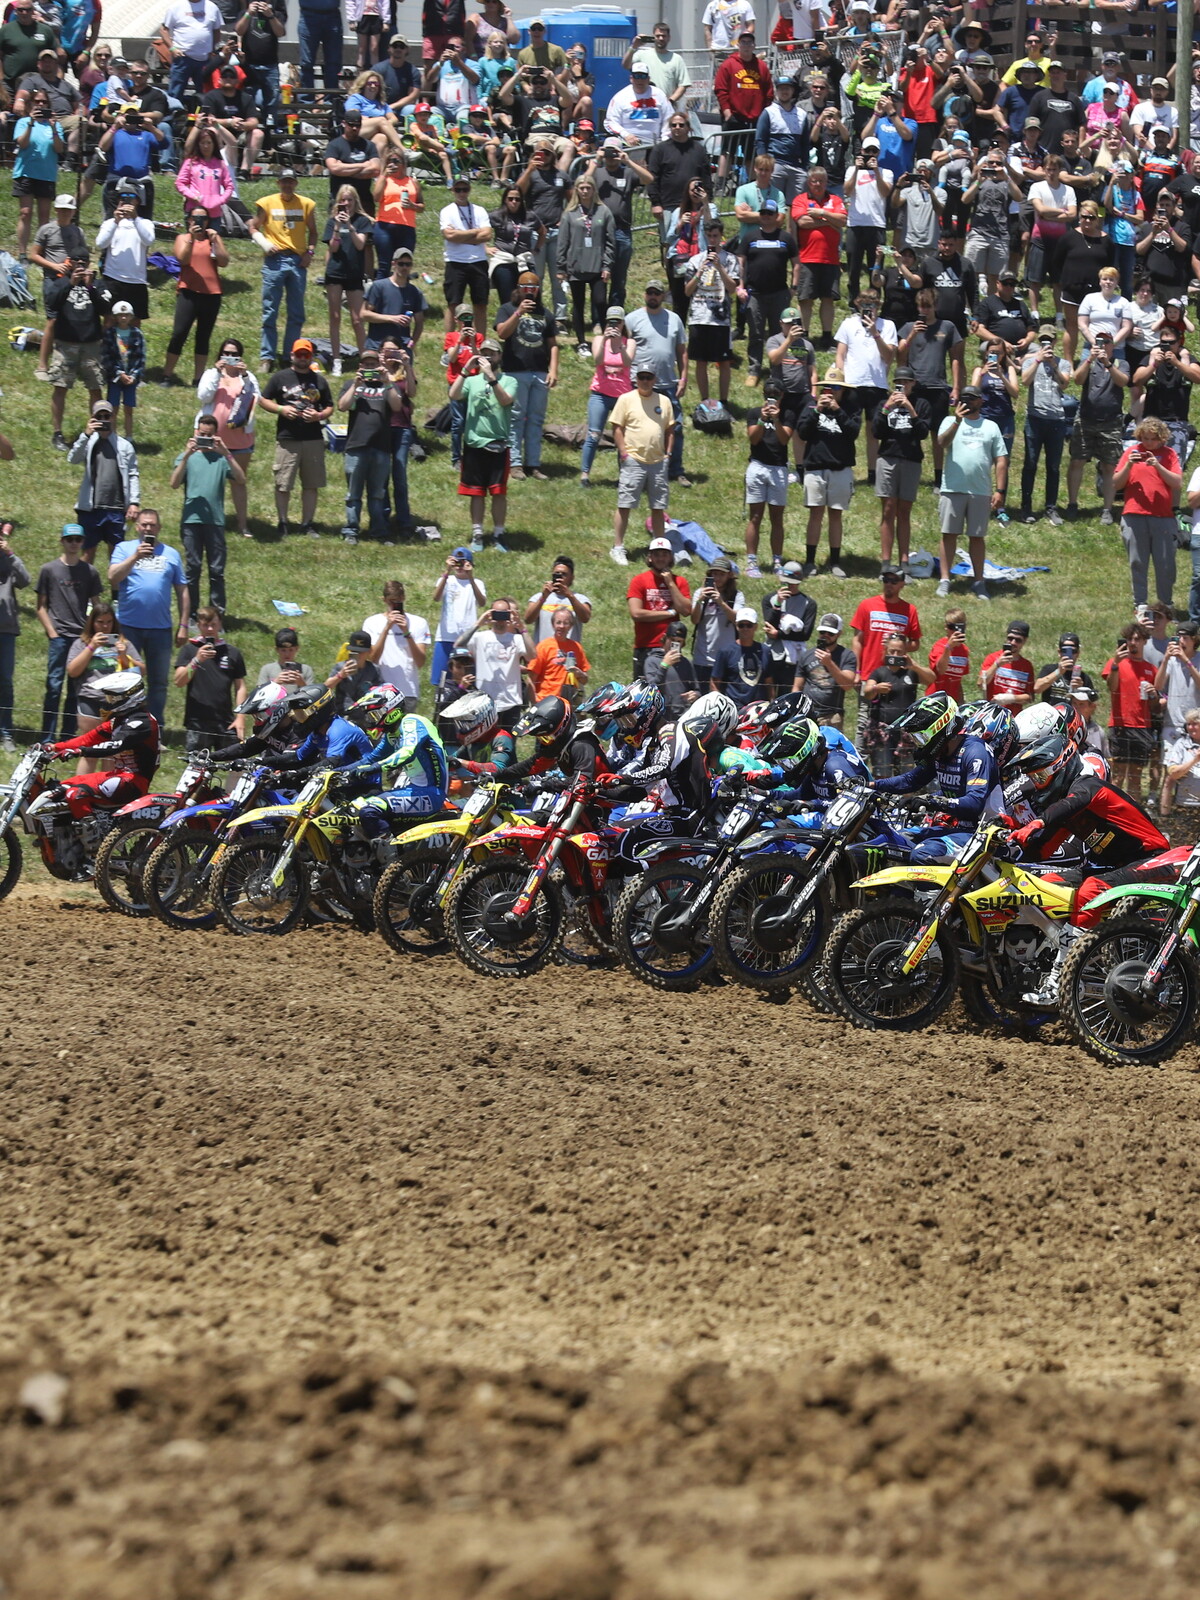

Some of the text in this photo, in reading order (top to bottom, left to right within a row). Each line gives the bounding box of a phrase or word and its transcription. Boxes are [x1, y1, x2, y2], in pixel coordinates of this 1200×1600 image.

[934, 279, 962, 288] adidas
[937, 771, 962, 786] THOR
[318, 815, 362, 827] SUZU
[690, 880, 713, 913] DUNLOP
[793, 874, 818, 910] DUNLOP
[975, 893, 1044, 911] SUZUKI
[908, 934, 934, 967] PIRELLI
